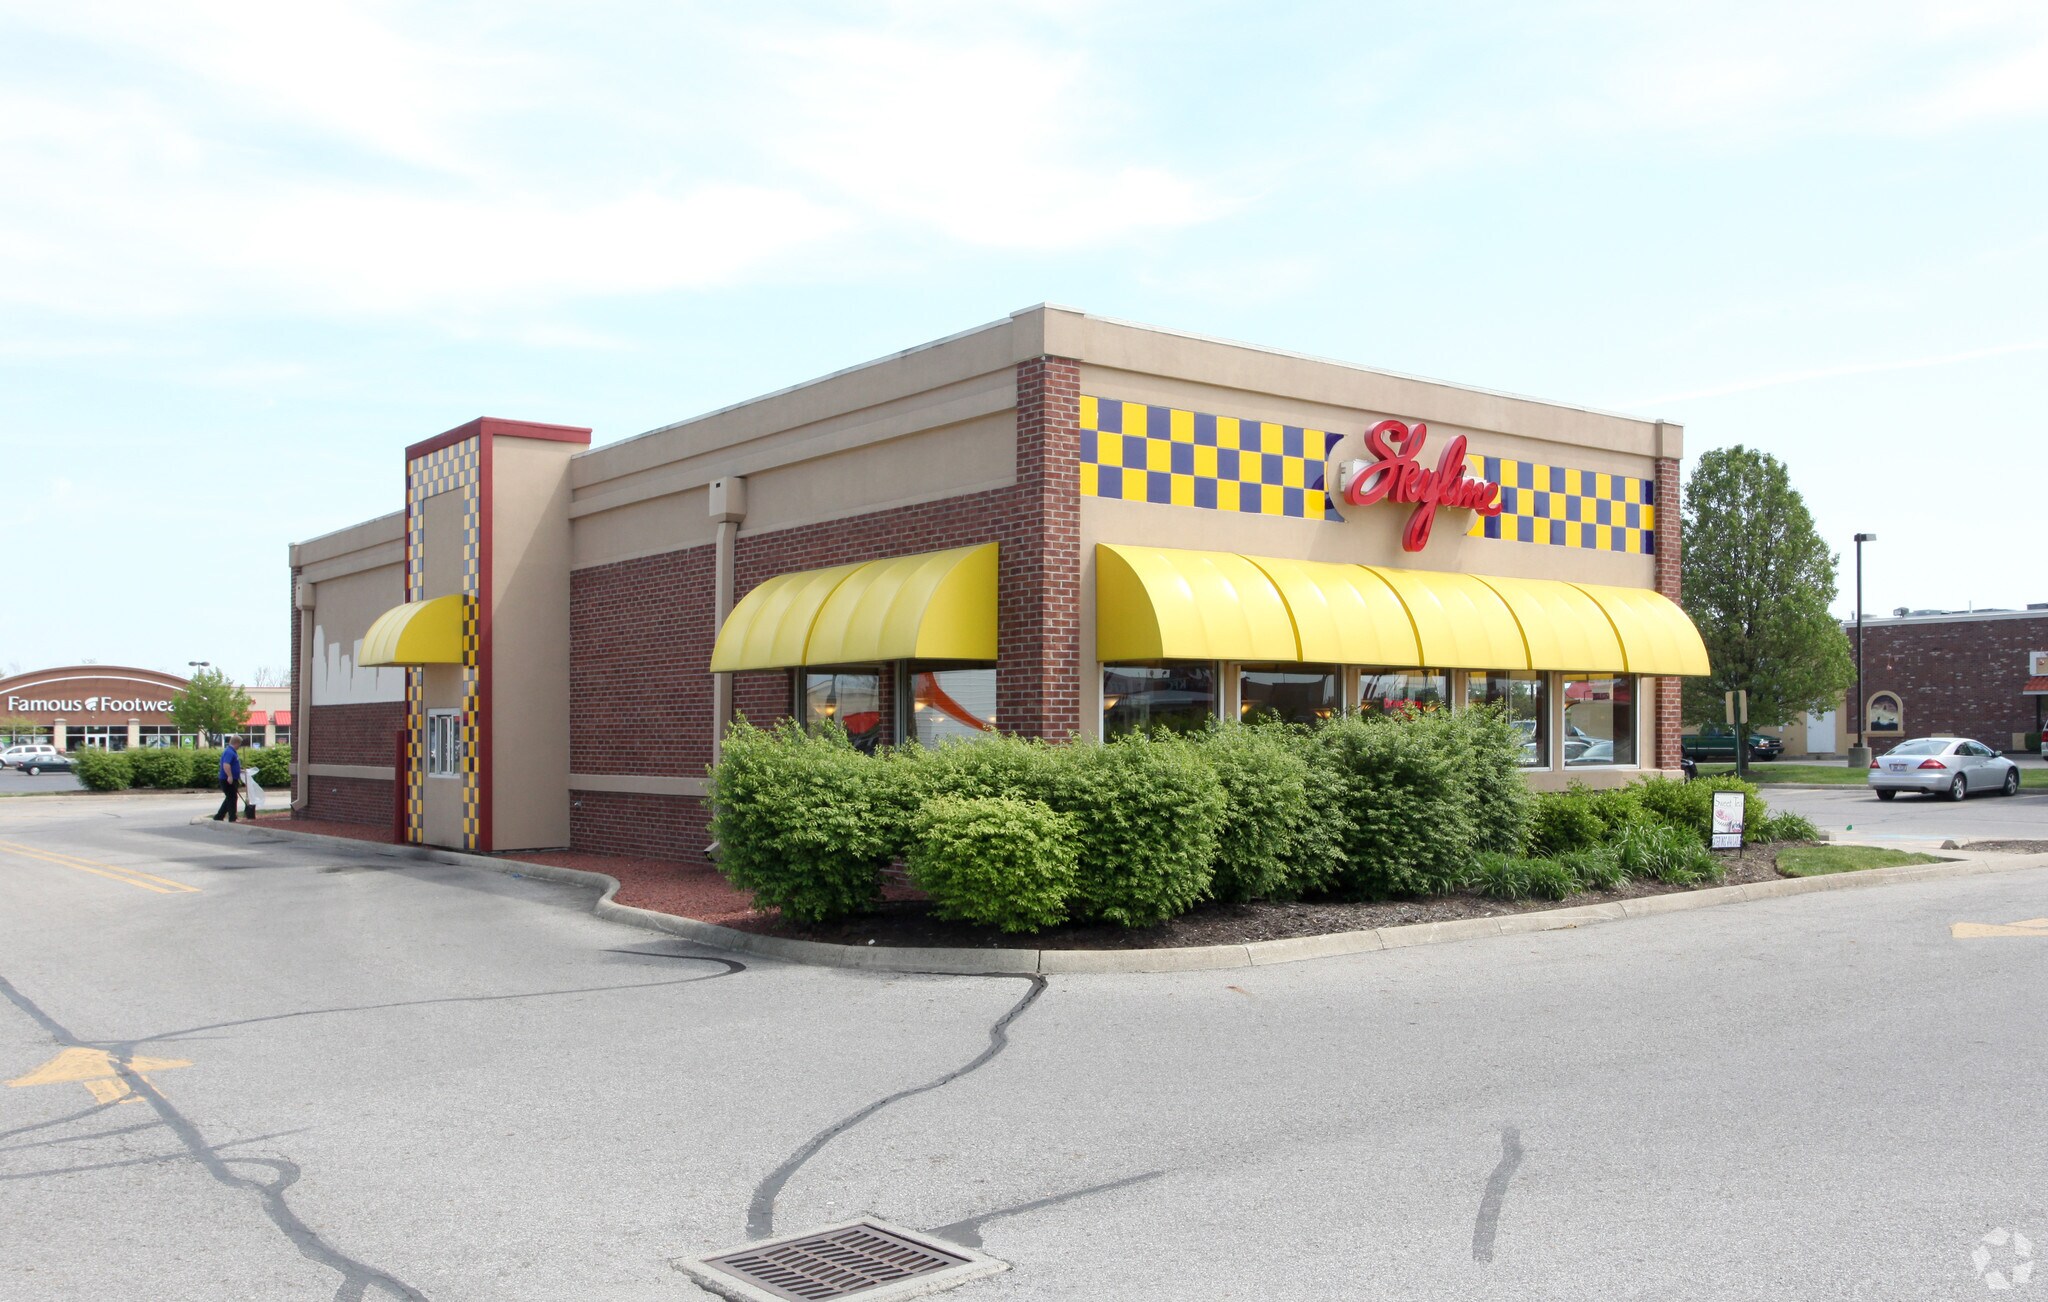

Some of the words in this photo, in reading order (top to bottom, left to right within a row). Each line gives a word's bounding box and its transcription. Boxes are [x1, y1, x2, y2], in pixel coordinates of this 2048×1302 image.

[1344, 420, 1502, 552] Skyline
[8, 696, 82, 711] Famous
[101, 696, 177, 711] Footwea
